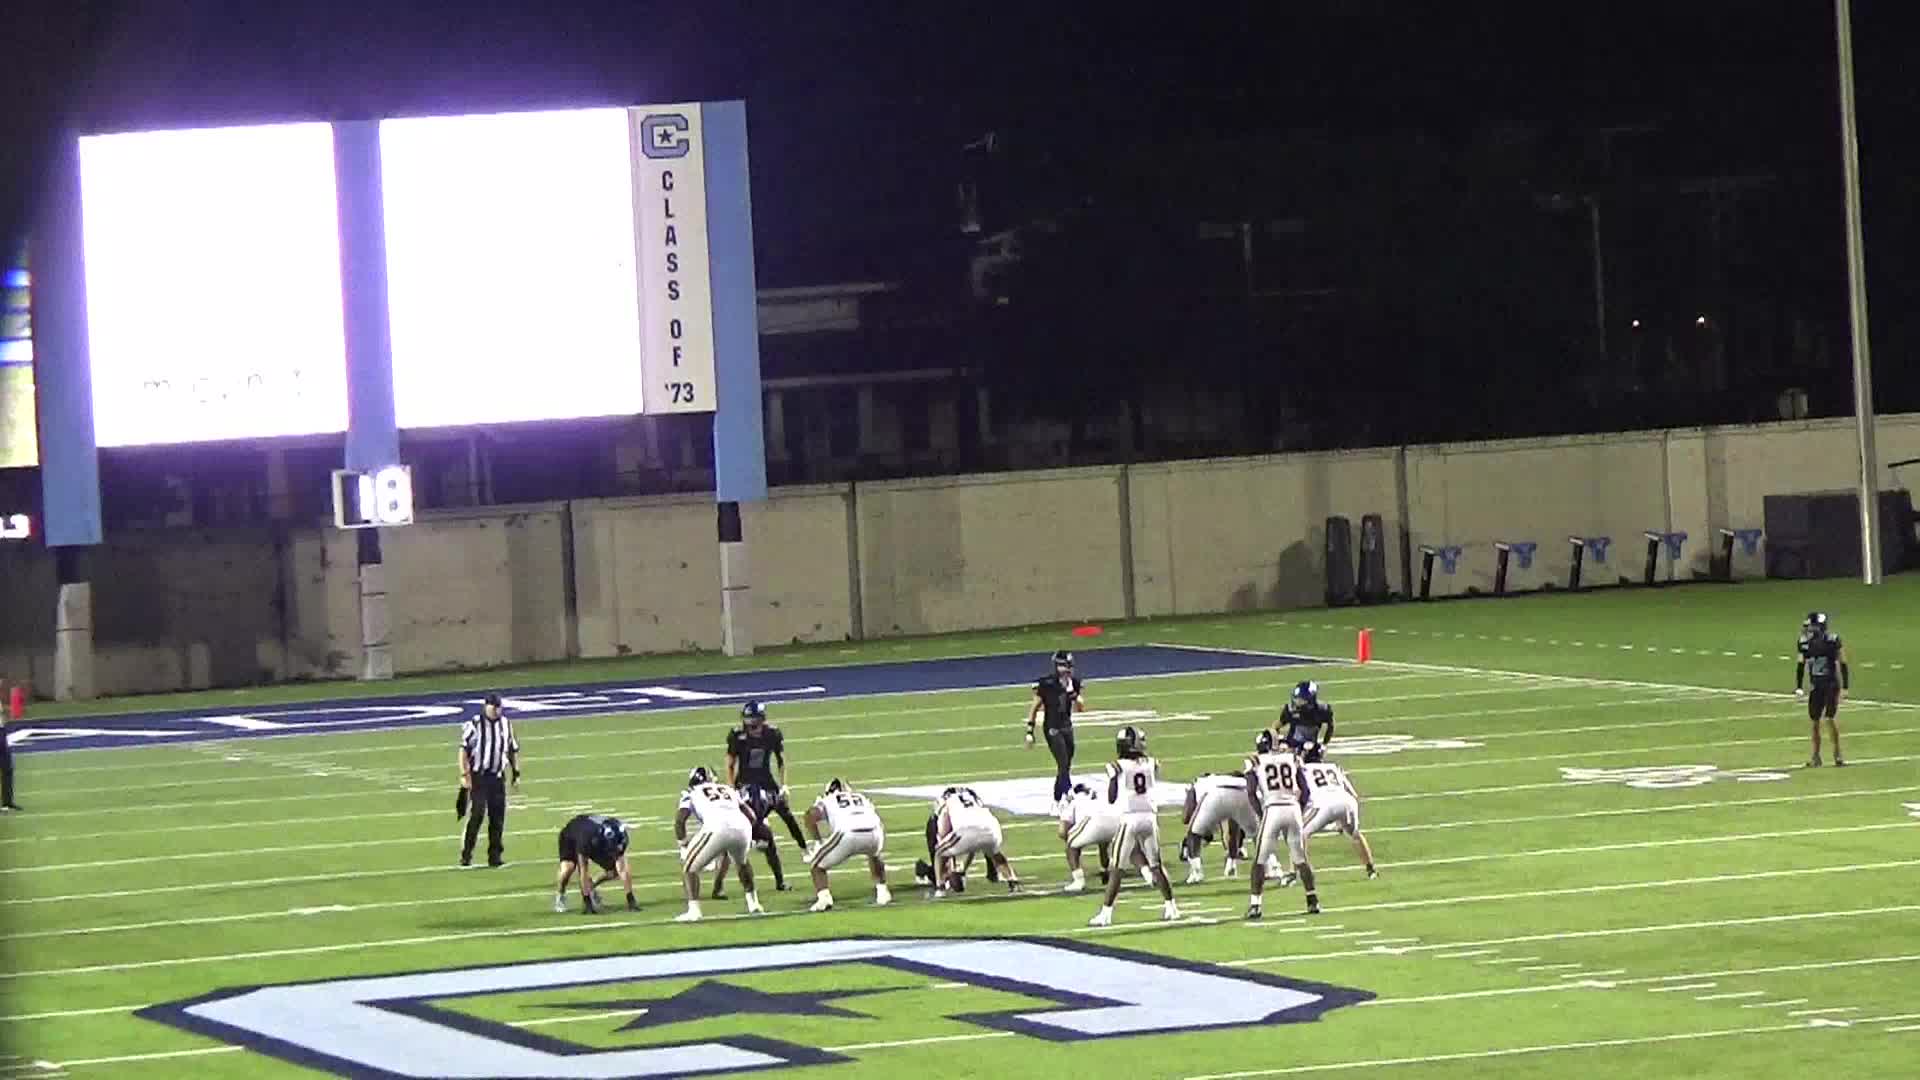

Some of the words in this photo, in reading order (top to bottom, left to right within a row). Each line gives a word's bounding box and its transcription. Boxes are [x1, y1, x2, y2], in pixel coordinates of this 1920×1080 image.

[660, 169, 680, 301] CLASS
[669, 318, 683, 368] OF
[664, 383, 695, 404] '73
[358, 466, 410, 522] 18
[1265, 763, 1294, 791] 28
[1312, 768, 1340, 788] 23
